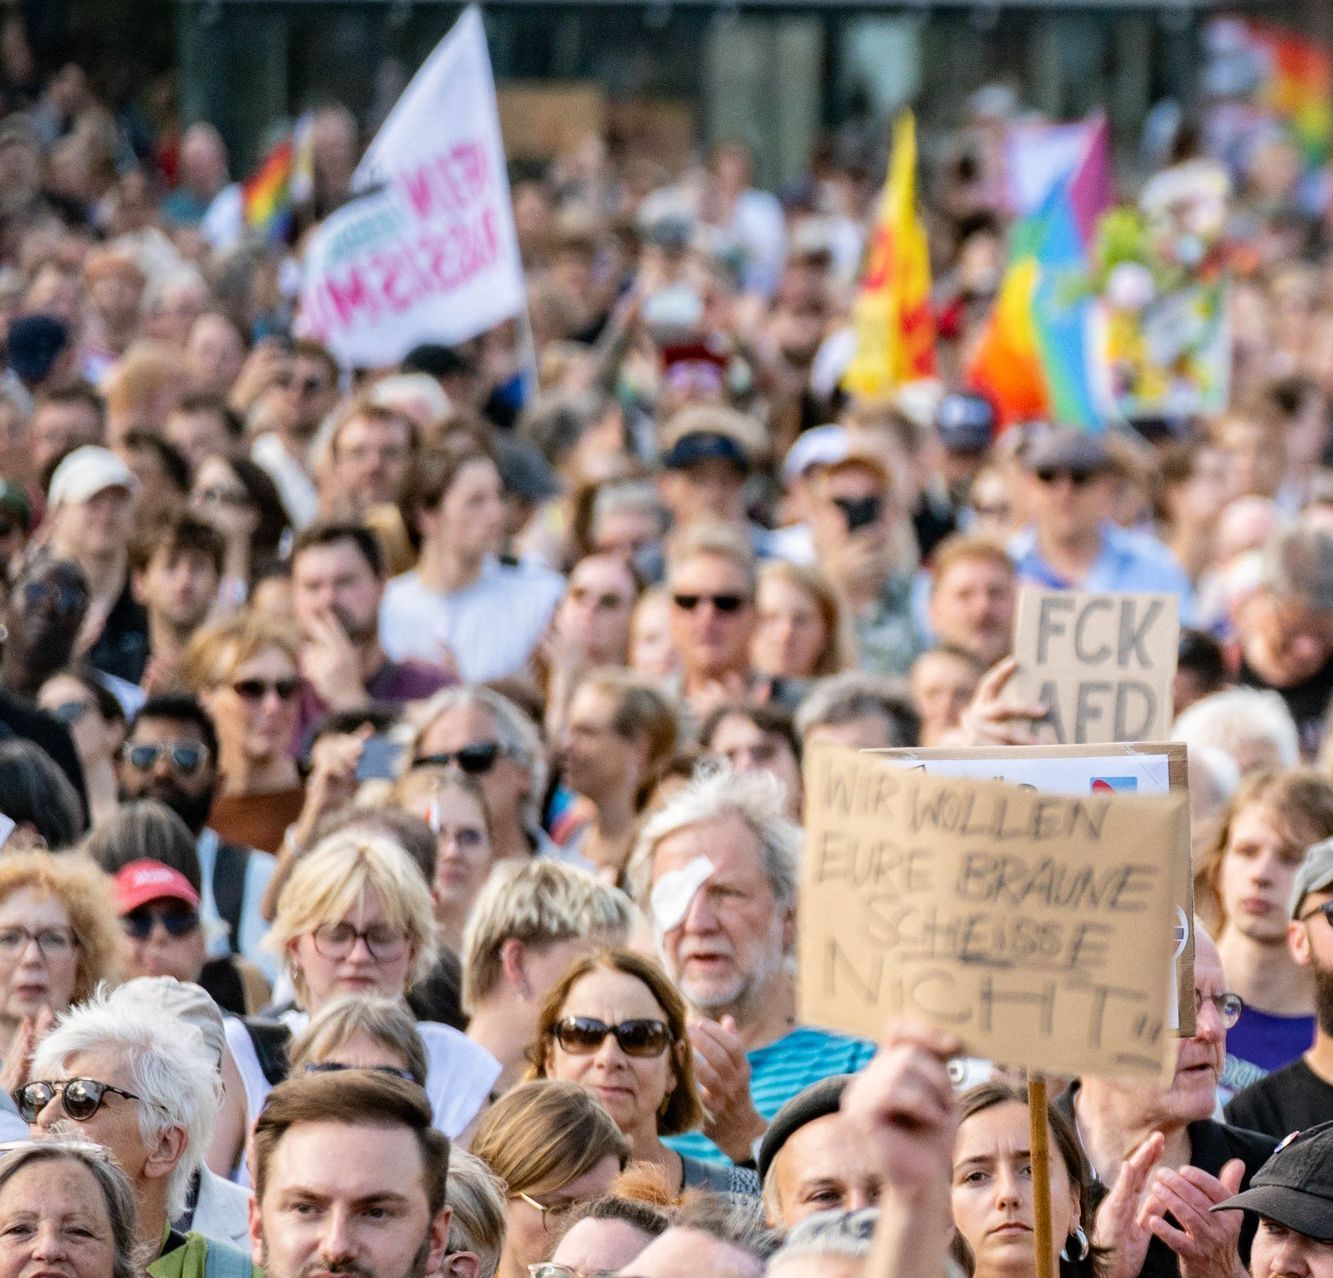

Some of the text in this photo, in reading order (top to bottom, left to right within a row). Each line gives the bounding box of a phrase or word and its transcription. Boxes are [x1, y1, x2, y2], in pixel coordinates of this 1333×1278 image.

[1036, 597, 1166, 671] FCK
[822, 753, 897, 821] WIR
[908, 780, 1113, 843] WOLLEN
[814, 827, 1163, 914] EURE BRAUNE
